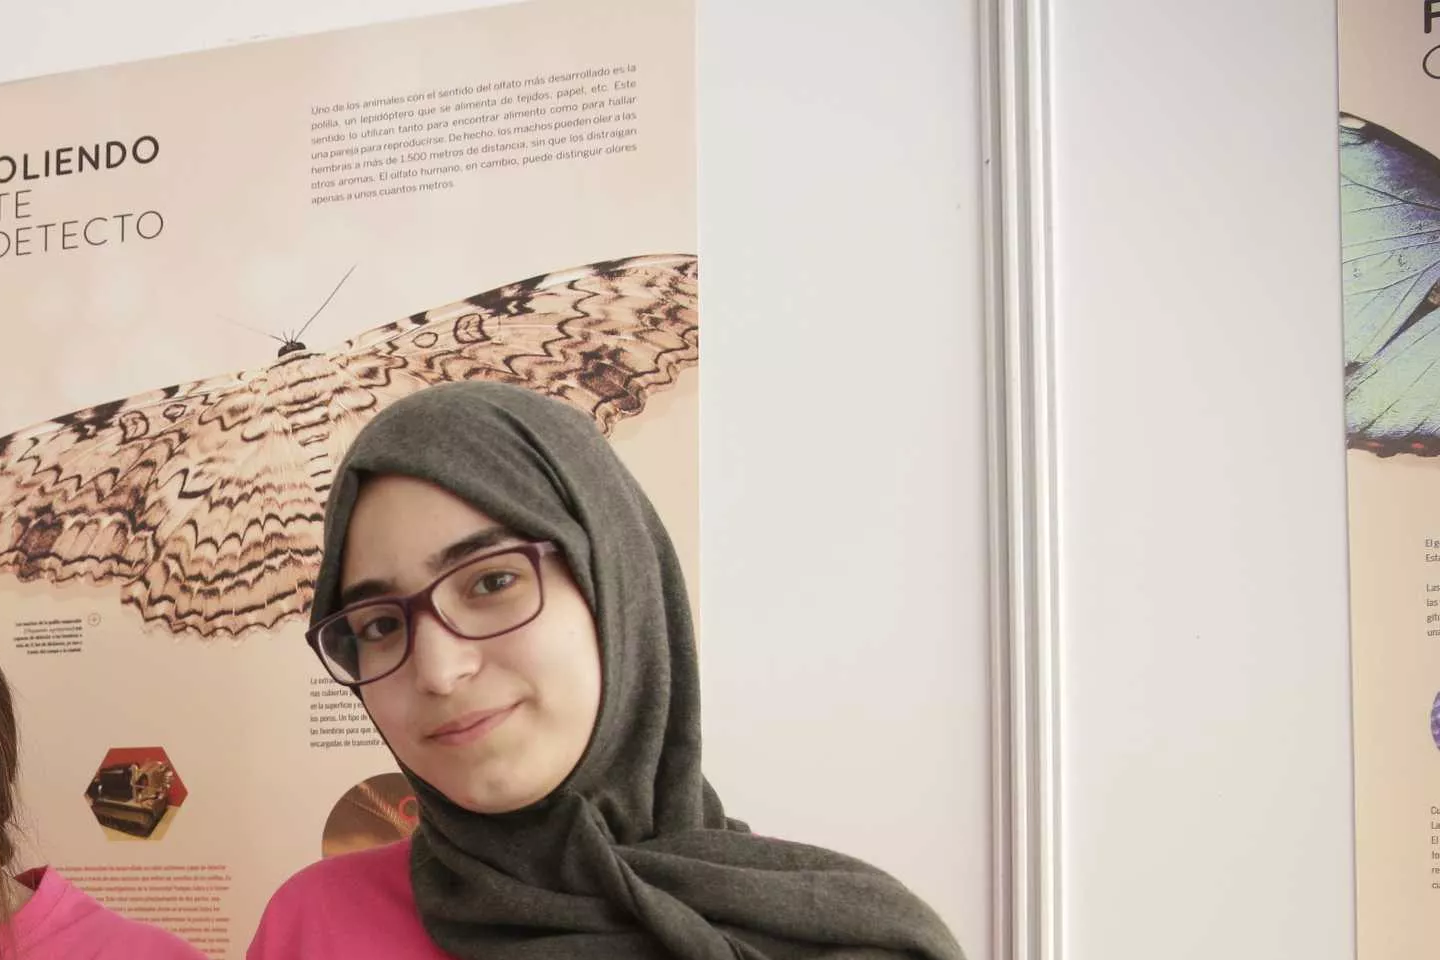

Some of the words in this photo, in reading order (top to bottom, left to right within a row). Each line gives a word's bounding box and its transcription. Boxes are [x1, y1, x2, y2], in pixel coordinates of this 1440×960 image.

[310, 105, 330, 115] Uno
[332, 103, 344, 112] de
[346, 101, 360, 111] los
[362, 95, 406, 108] animales
[406, 94, 424, 103] con
[426, 90, 436, 100] el
[438, 86, 474, 99] sentido
[476, 83, 492, 94] del
[493, 80, 522, 92] olfato
[524, 77, 546, 87] más
[548, 68, 610, 84] desarrollado
[612, 68, 624, 76] es
[627, 65, 636, 74] la
[344, 116, 356, 124] un
[360, 109, 414, 124] lepidóptero
[418, 106, 436, 118] que
[440, 105, 450, 113] se
[454, 97, 496, 111] alimenta
[500, 95, 512, 105] de
[614, 79, 636, 90] Este
[310, 133, 346, 146] sentido
[348, 131, 358, 141] lo
[360, 128, 394, 139] utilizan
[398, 123, 424, 134] tanto
[426, 121, 449, 133] para
[452, 114, 500, 127] encontrar
[503, 107, 546, 120] alimento
[550, 104, 578, 114] como
[582, 101, 604, 112] para
[608, 95, 636, 107] hallar
[310, 151, 328, 160] una
[330, 146, 359, 160] pareja
[360, 144, 382, 156] para
[448, 133, 462, 143] De
[498, 127, 512, 137] los
[513, 123, 553, 135] machos
[554, 118, 592, 132] pueden
[592, 115, 613, 125] oler
[614, 115, 620, 123] a
[622, 112, 637, 122] las
[310, 162, 352, 174] hembras
[362, 157, 384, 168] más
[386, 156, 398, 165] de
[429, 149, 464, 160] metros
[466, 146, 479, 156] de
[531, 138, 546, 148] sin
[547, 137, 566, 148] que
[569, 134, 584, 143] los
[586, 128, 637, 141] distraigan
[310, 179, 336, 190] otros
[379, 171, 388, 181] El
[390, 168, 418, 179] olfato
[465, 162, 478, 170] en
[522, 152, 552, 166] puede
[556, 146, 602, 160] distinguir
[604, 144, 637, 155] olores
[311, 194, 346, 206] apenas
[378, 184, 418, 196] cuantos
